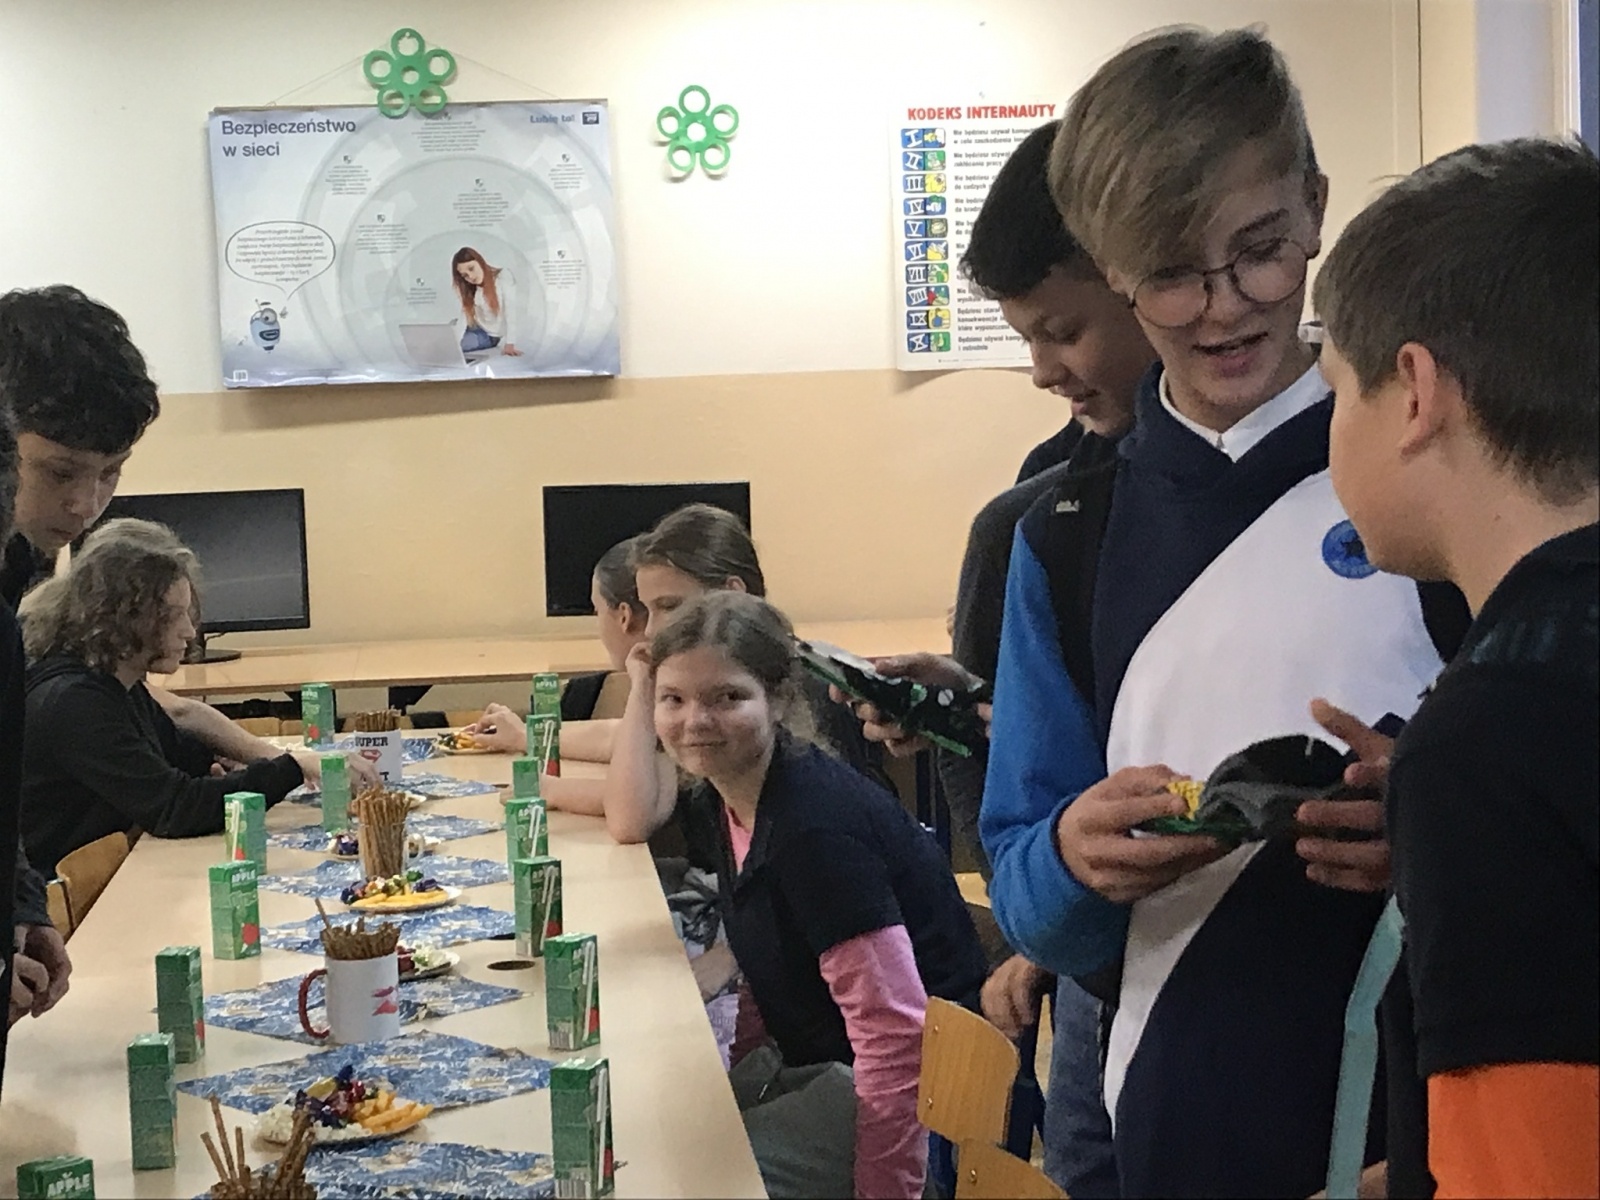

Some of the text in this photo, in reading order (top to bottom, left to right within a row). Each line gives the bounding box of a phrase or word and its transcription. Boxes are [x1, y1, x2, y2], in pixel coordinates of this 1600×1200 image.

[907, 104, 1056, 120] KODEKS INTERNAUTY
[221, 118, 356, 138] Bezpieczeństwo
[222, 141, 281, 157] w sieci
[46, 1171, 91, 1198] APPLE
